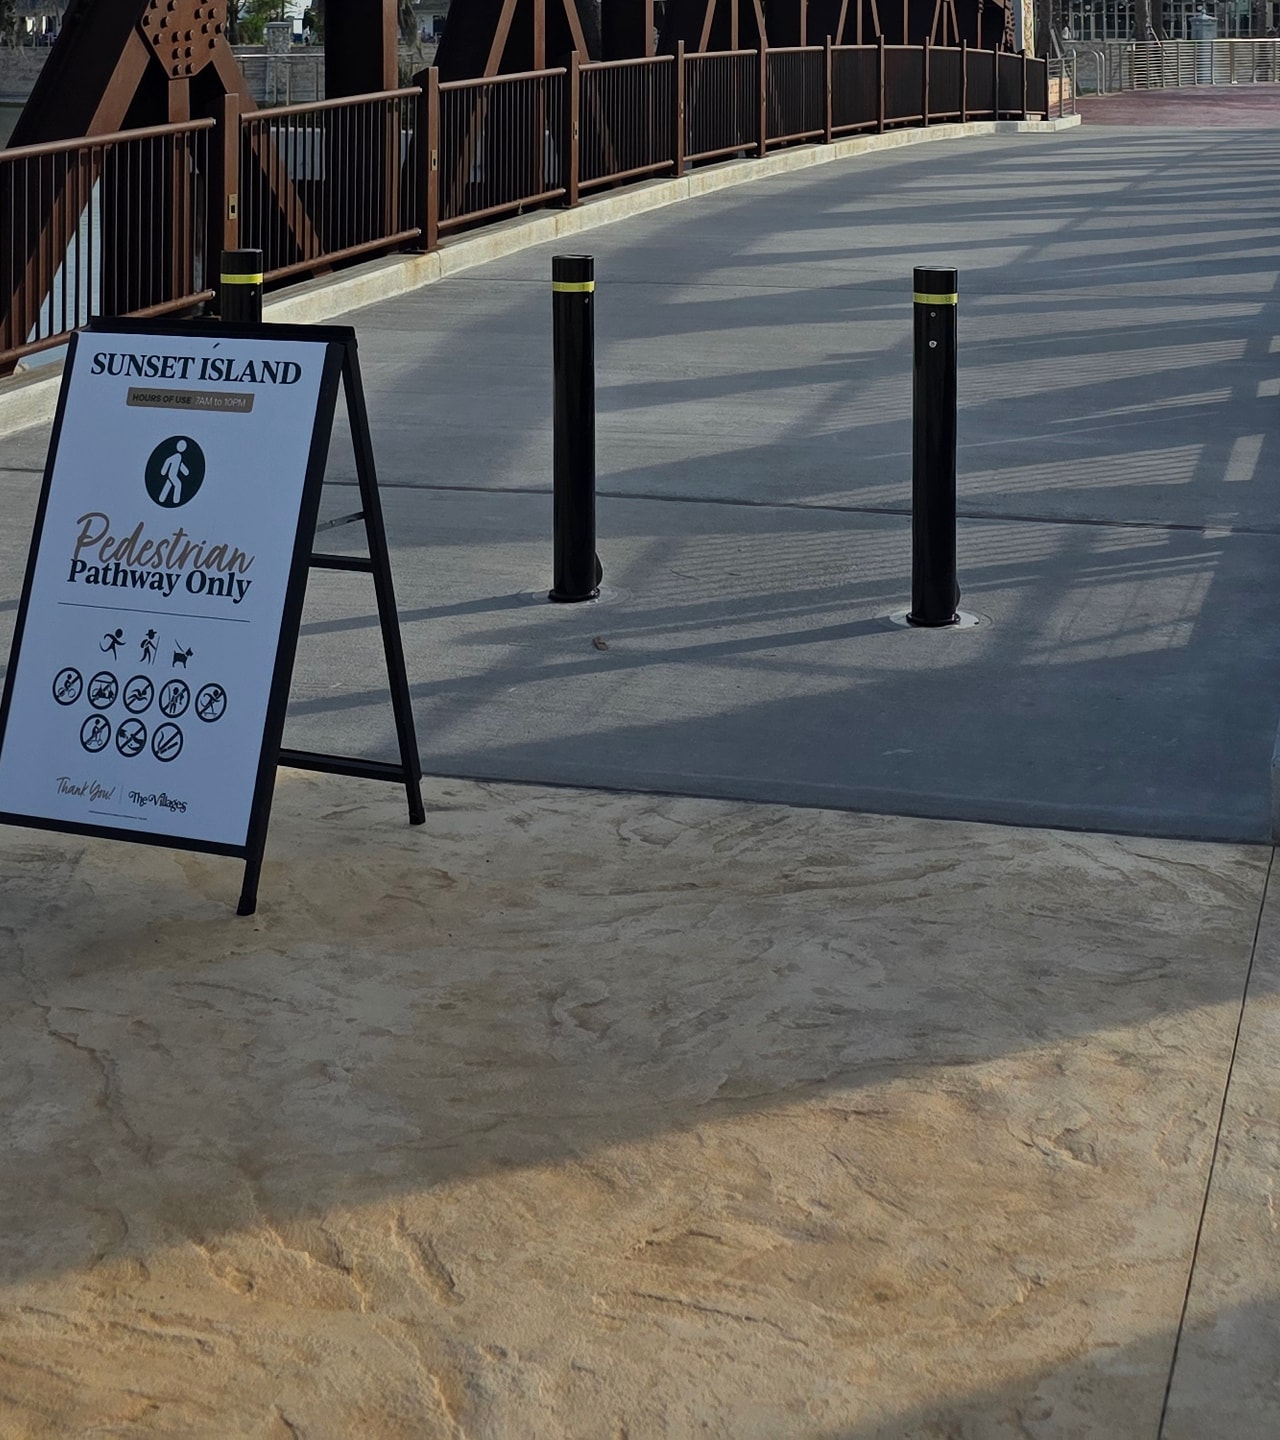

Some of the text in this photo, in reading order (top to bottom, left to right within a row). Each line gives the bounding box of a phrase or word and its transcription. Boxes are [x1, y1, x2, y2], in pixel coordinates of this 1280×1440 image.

[90, 352, 302, 385] SUNSET ISLAND
[132, 393, 247, 408] HOURS OF USE 7AM to 10PM
[74, 512, 255, 574] Pedestrian
[67, 559, 252, 604] Pathway Only
[56, 776, 116, 801] Thank You!
[128, 790, 188, 813] The Villages
